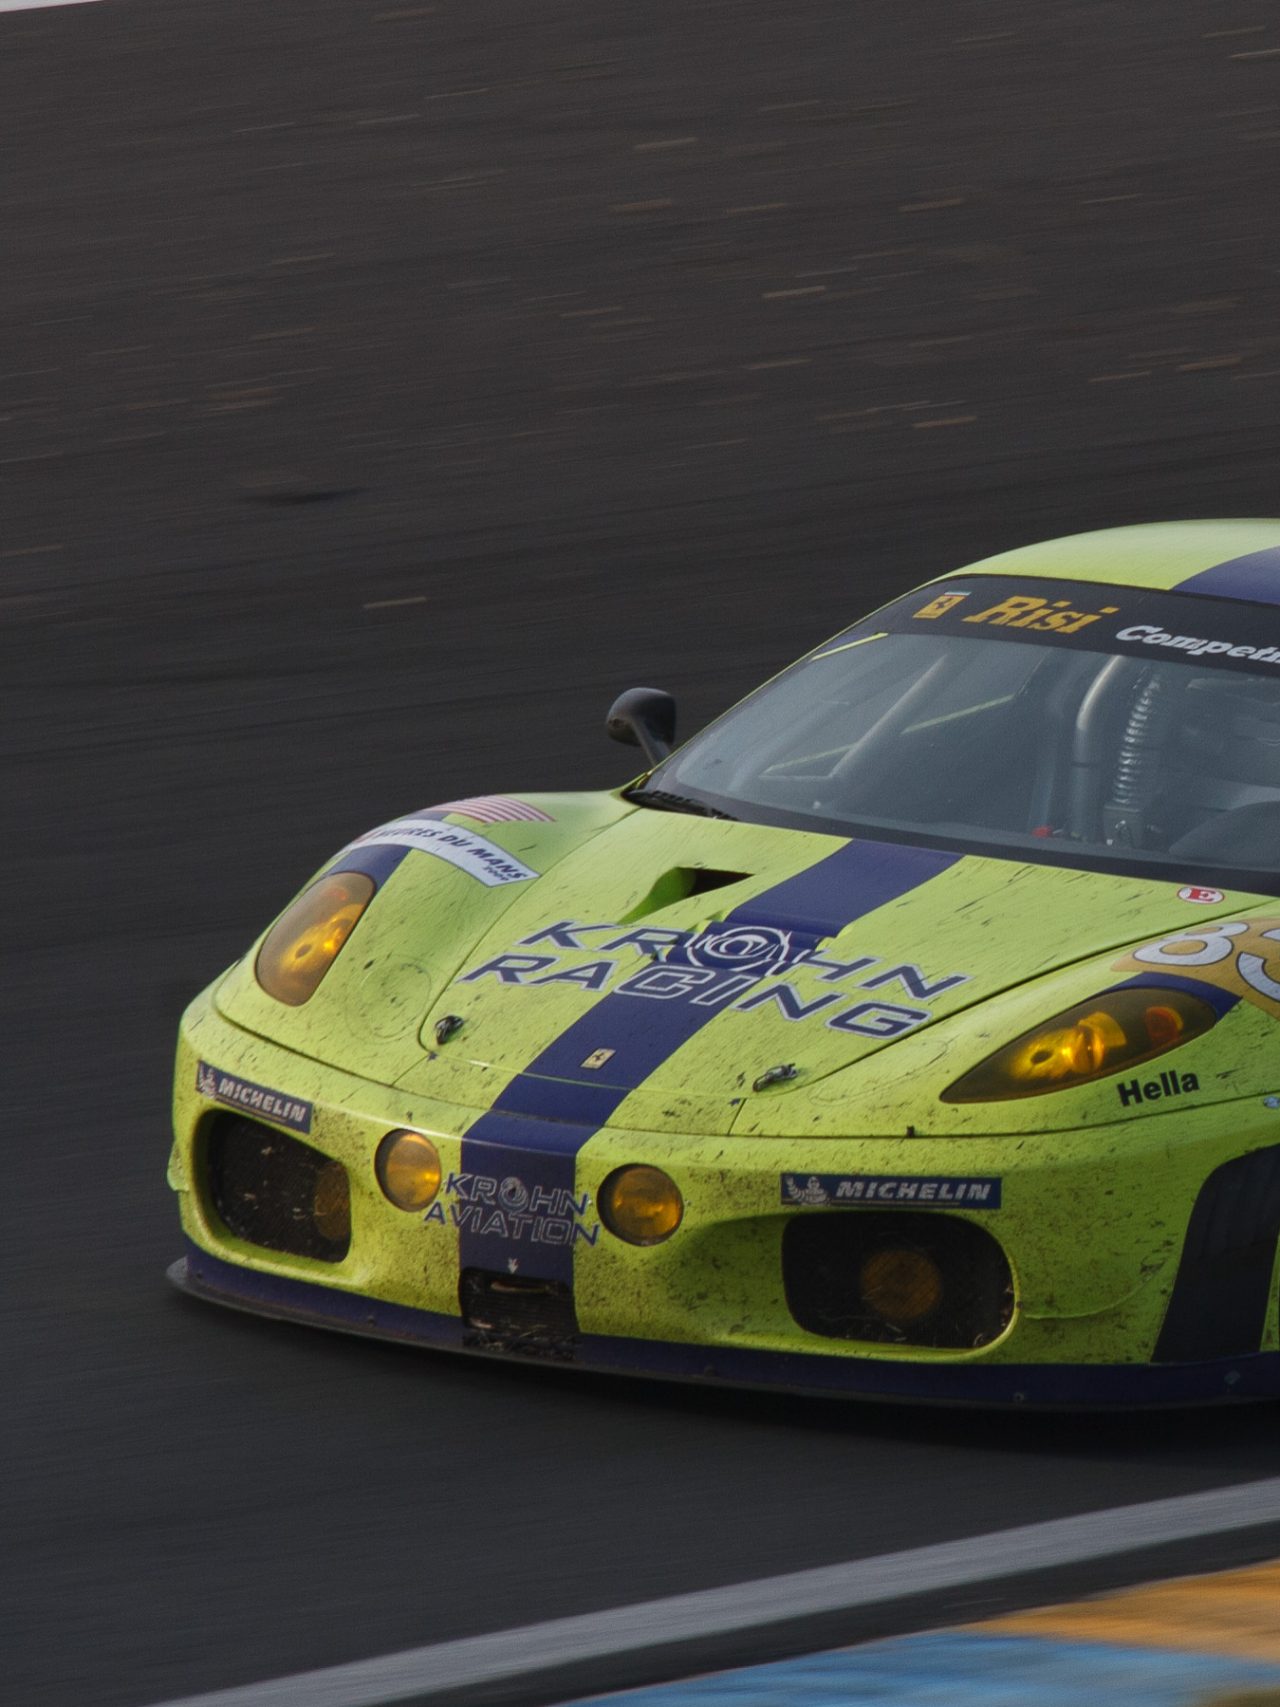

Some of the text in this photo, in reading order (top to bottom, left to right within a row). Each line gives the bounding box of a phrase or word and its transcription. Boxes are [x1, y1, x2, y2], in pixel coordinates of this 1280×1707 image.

[961, 596, 1120, 633] Risi
[440, 835, 473, 848] DU
[469, 849, 528, 879] MANS
[518, 921, 974, 999] KROHN
[459, 954, 932, 1037] RACING
[218, 1080, 306, 1123] MICHELIN
[1116, 1070, 1199, 1106] Hella
[445, 1172, 592, 1215] KROHN
[835, 1180, 993, 1202] MICHELIN
[424, 1202, 599, 1246] AVIATION
